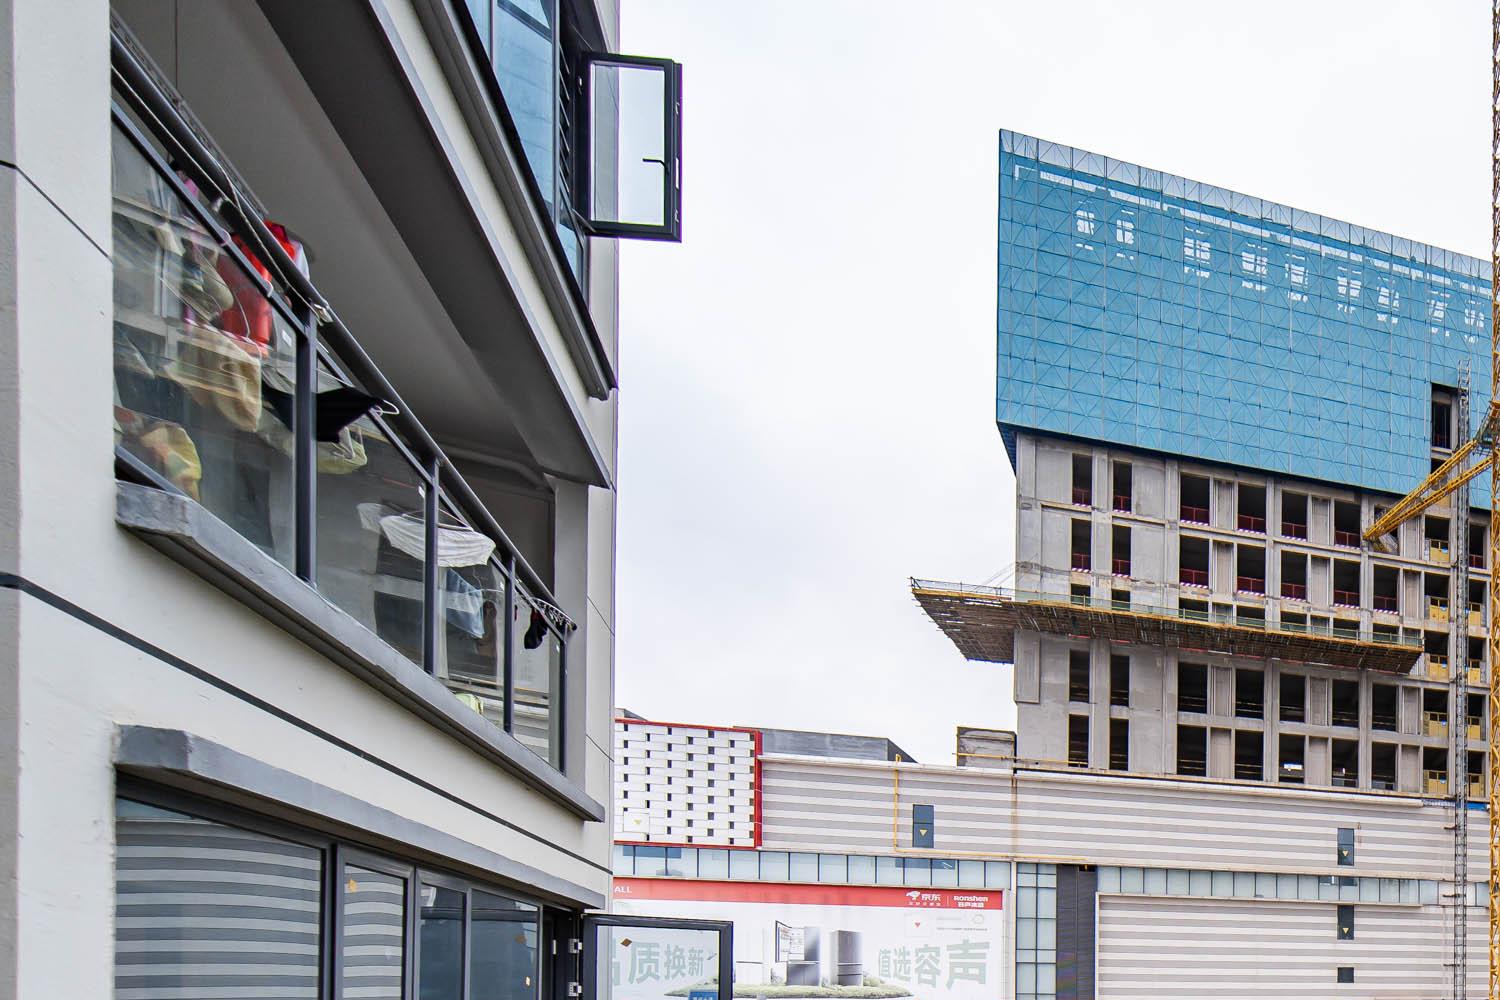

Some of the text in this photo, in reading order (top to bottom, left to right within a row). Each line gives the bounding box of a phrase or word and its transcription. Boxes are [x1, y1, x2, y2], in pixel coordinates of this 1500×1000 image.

[921, 893, 941, 902] 京东
[879, 939, 990, 990] 值选容声
